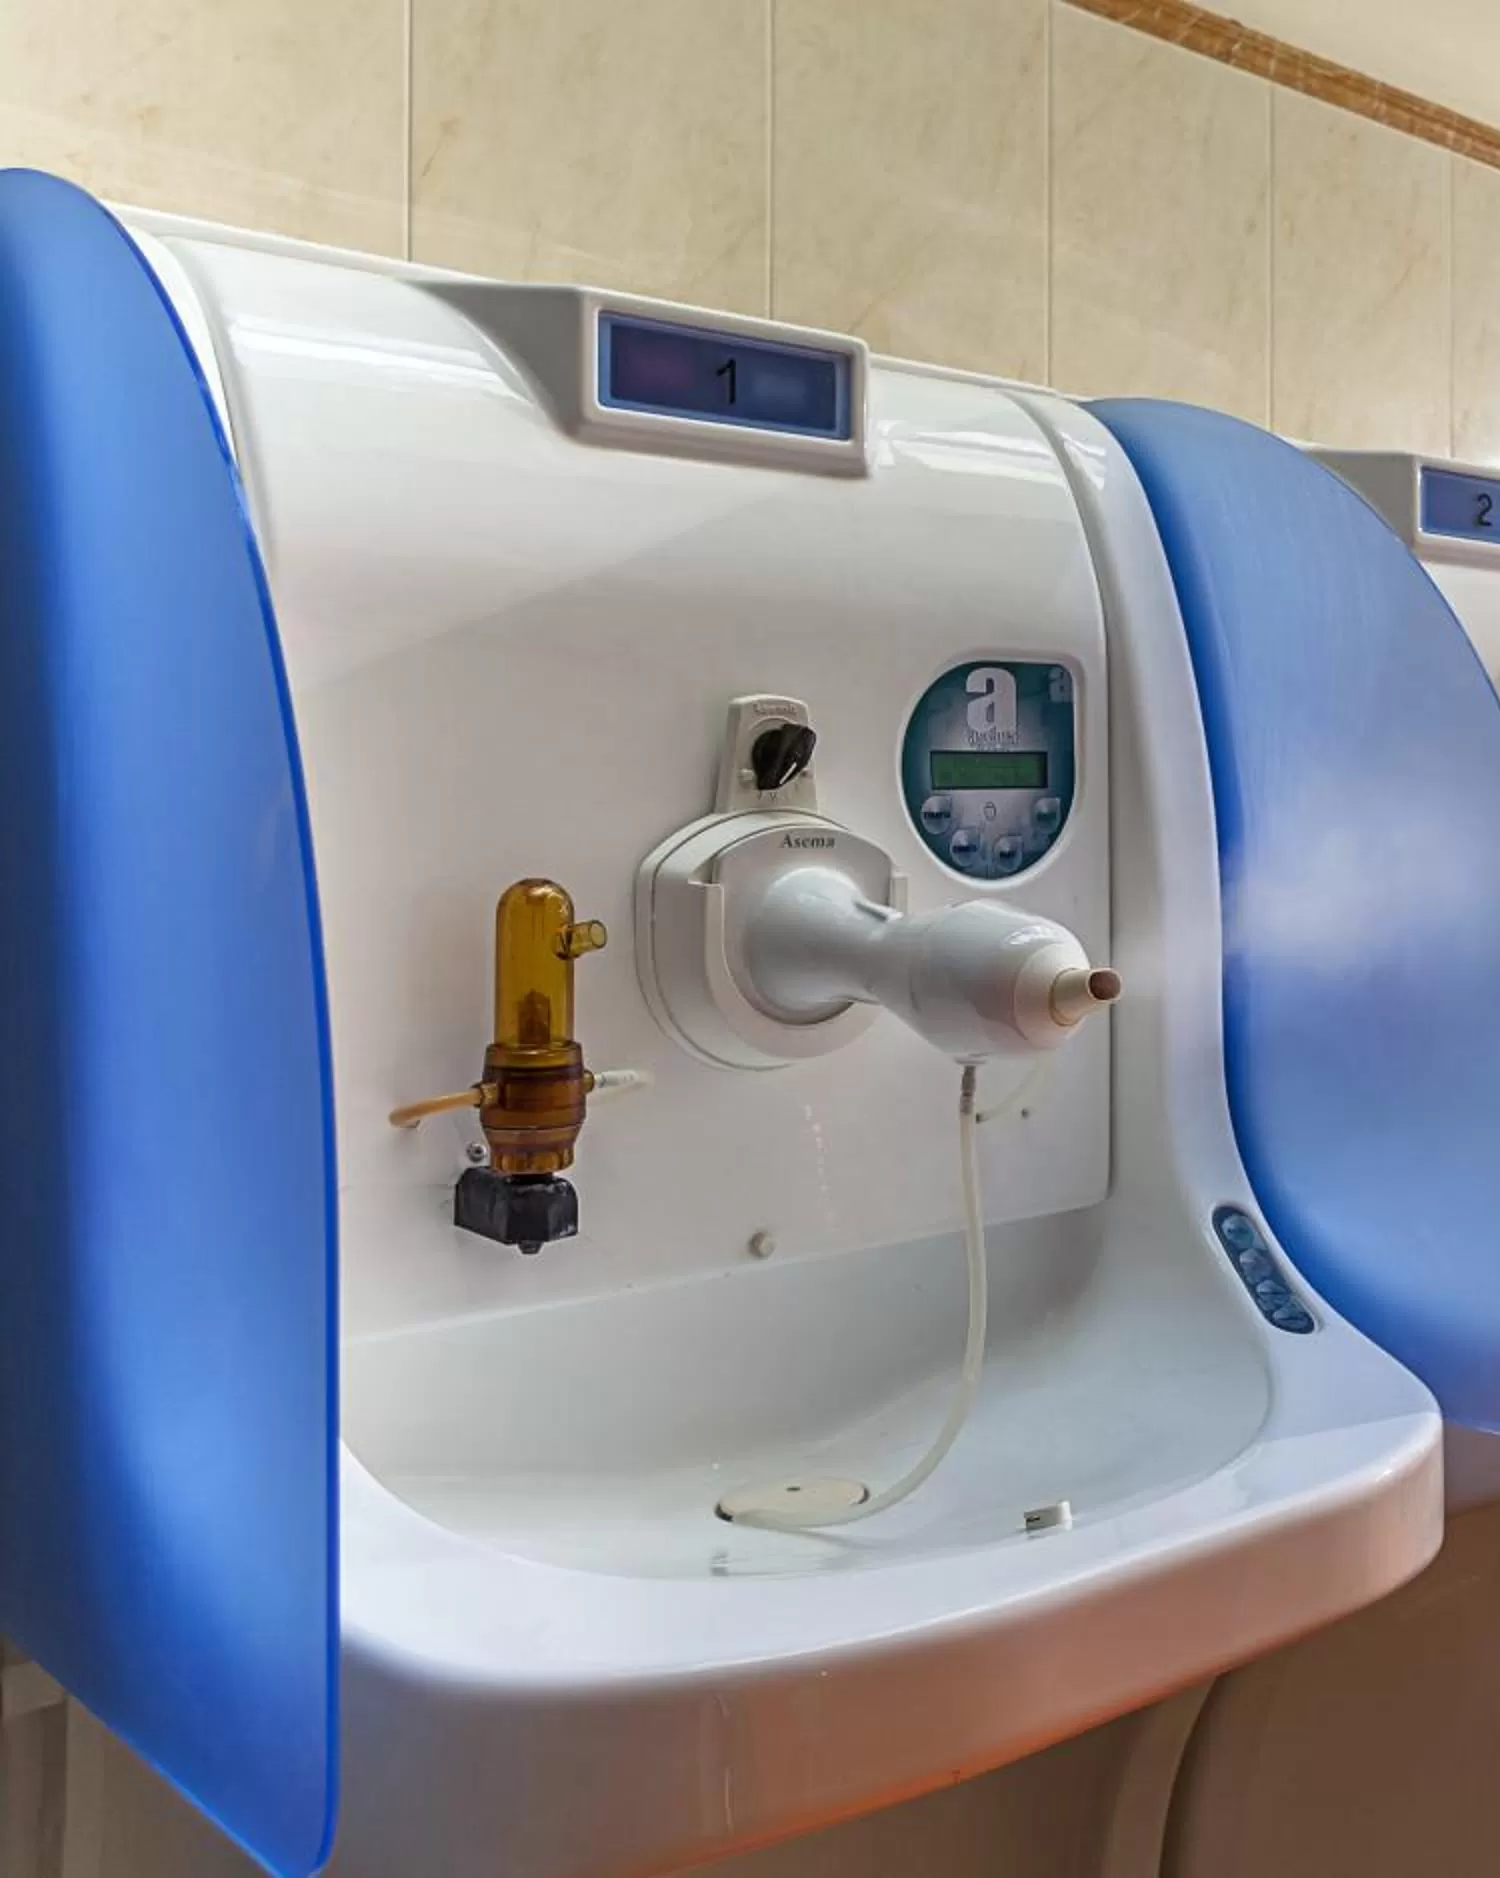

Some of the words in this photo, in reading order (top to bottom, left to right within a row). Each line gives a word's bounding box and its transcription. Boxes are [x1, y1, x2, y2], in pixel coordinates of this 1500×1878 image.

[716, 357, 737, 405] 1
[1475, 492, 1493, 527] 2
[965, 667, 1018, 733] a
[778, 833, 836, 849] Asema
